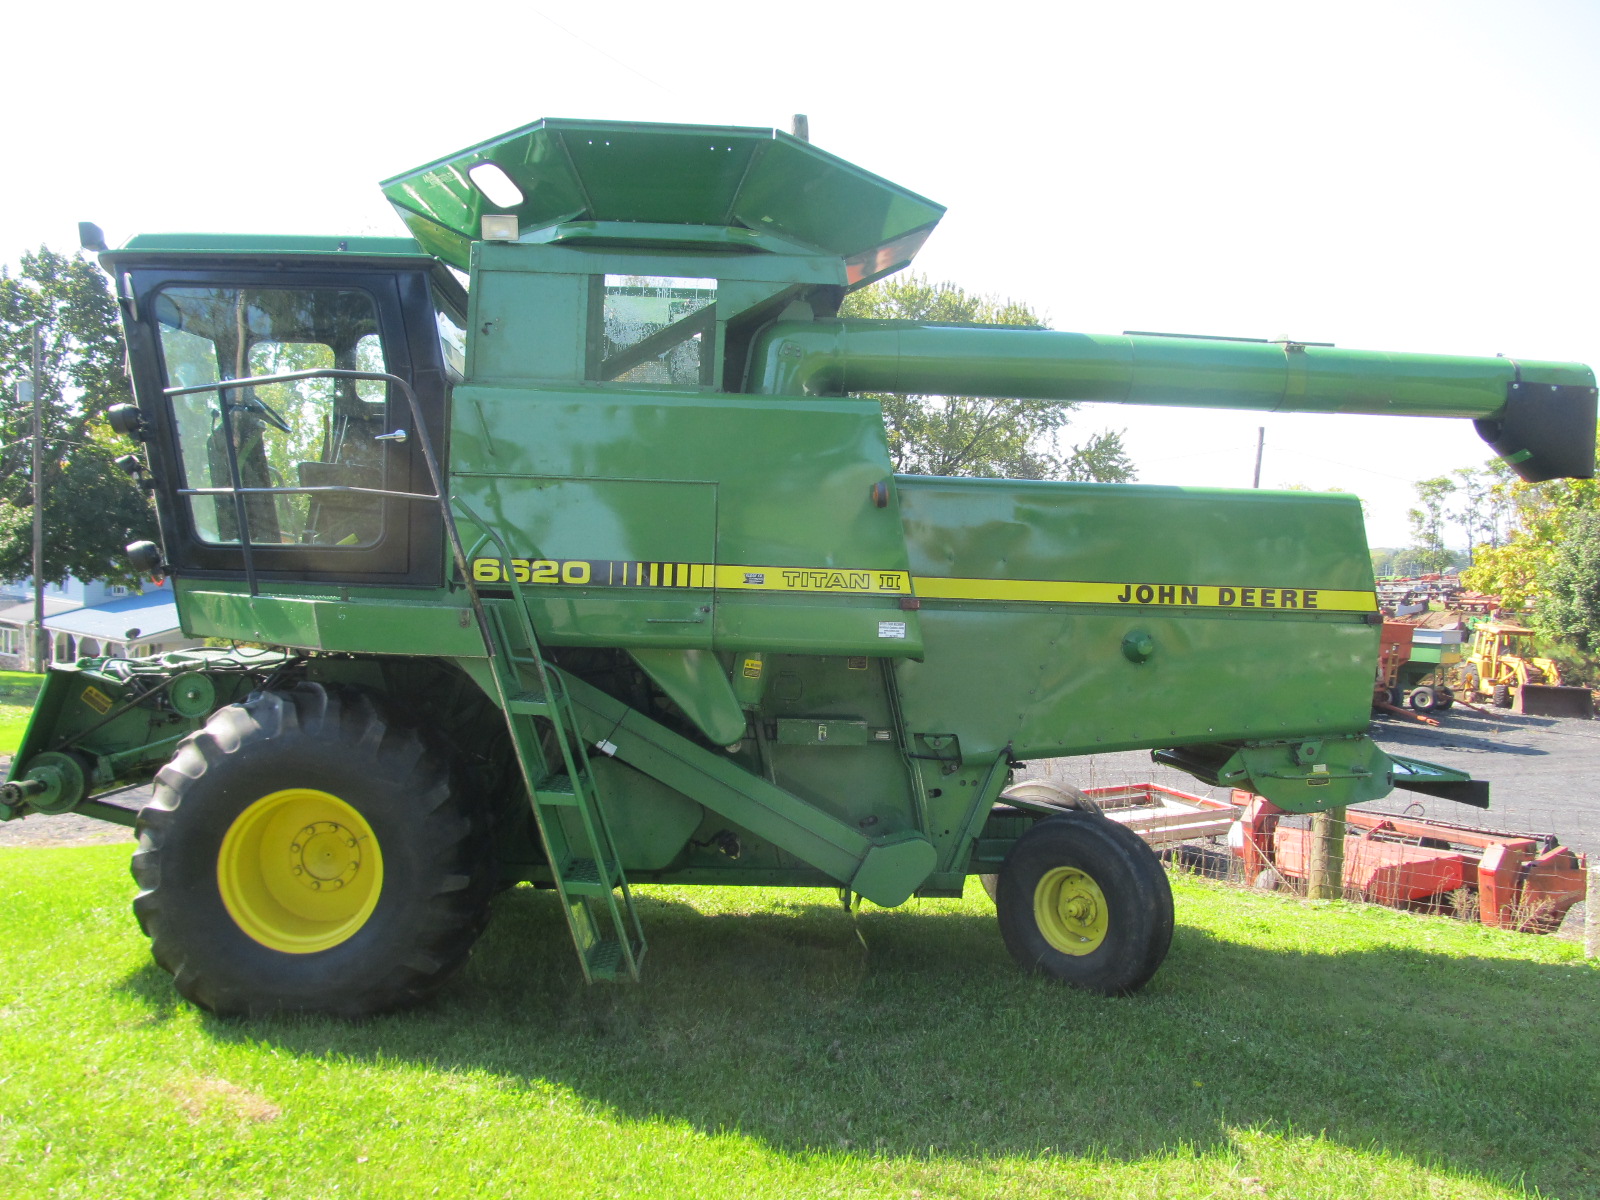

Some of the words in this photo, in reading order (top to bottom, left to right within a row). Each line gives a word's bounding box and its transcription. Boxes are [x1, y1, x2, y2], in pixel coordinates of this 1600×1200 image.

[473, 558, 591, 584] 6620
[782, 571, 870, 590] TITAN
[879, 574, 901, 590] II
[1117, 585, 1199, 605] JOHN
[1218, 587, 1318, 609] DEERE
